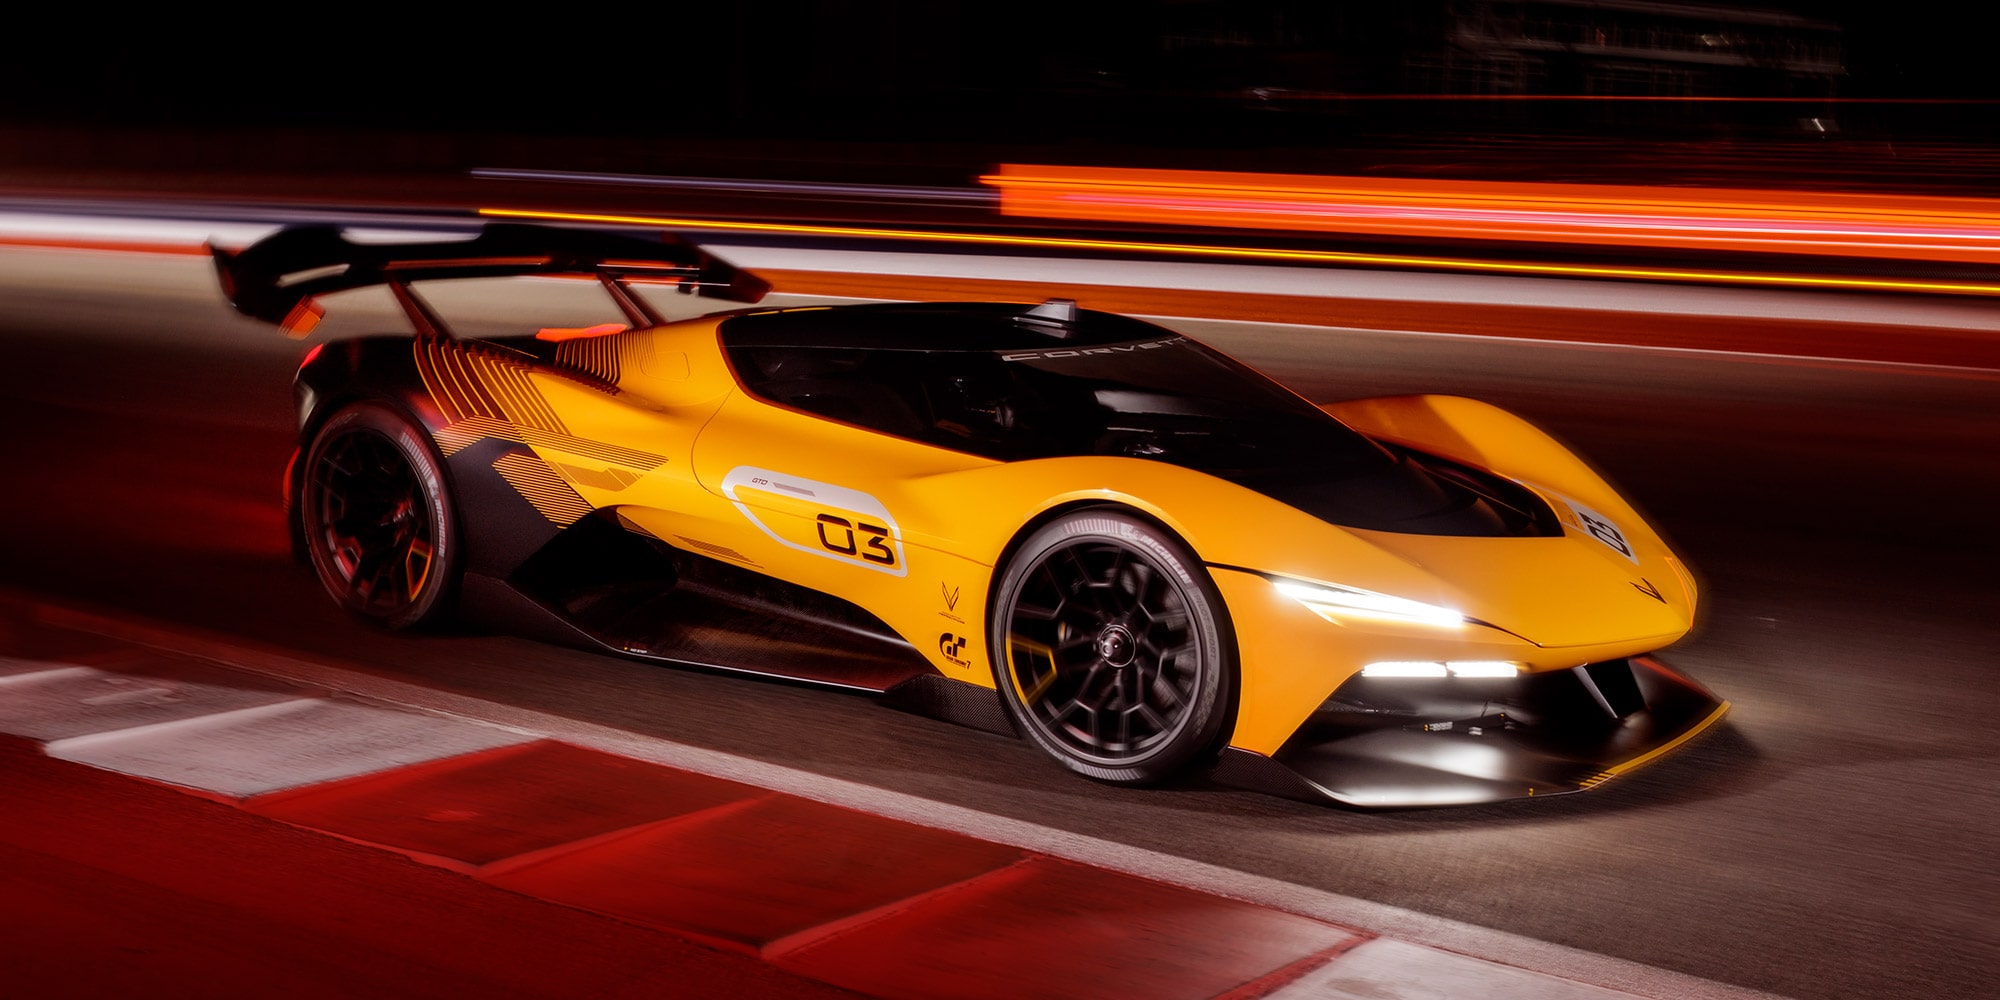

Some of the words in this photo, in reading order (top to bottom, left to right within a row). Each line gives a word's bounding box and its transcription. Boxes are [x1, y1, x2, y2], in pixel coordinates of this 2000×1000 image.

[816, 513, 895, 565] 03
[1140, 534, 1193, 585] MICHELIN
[1578, 511, 1631, 557] 03
